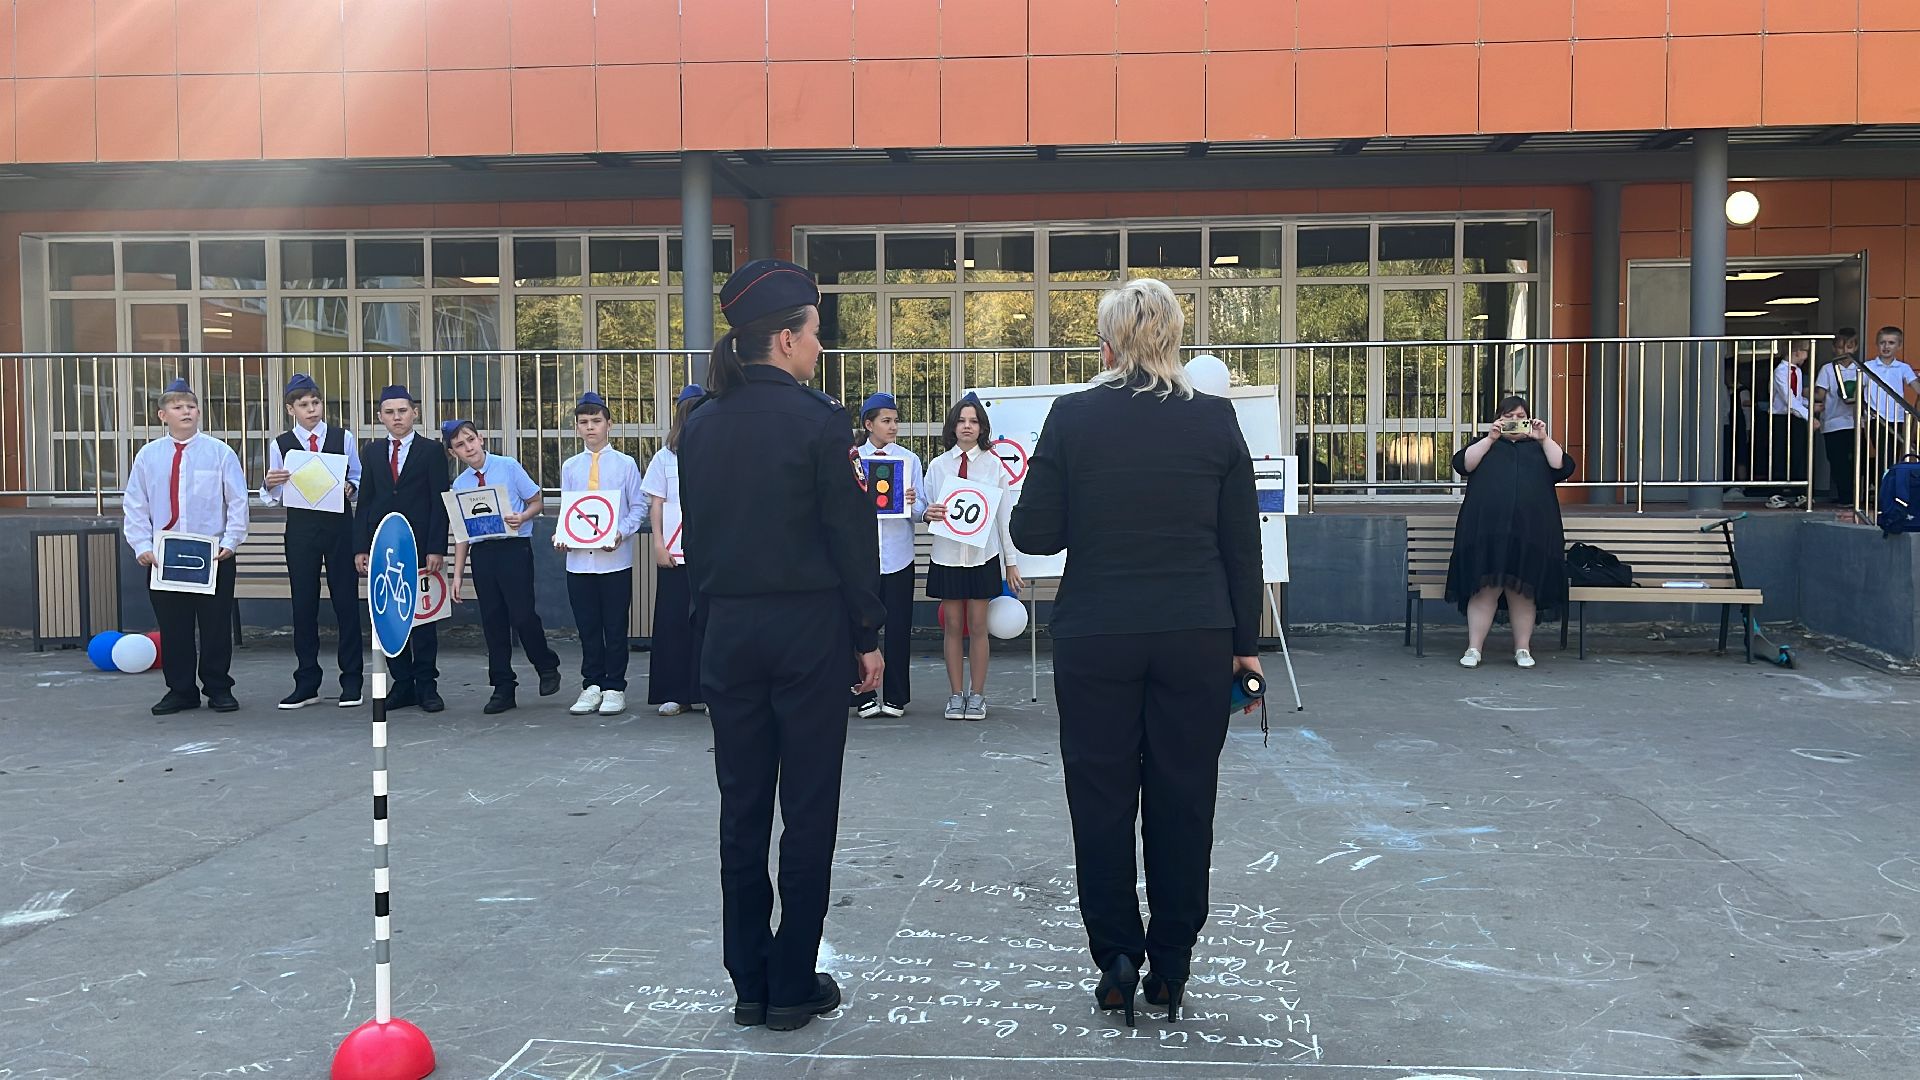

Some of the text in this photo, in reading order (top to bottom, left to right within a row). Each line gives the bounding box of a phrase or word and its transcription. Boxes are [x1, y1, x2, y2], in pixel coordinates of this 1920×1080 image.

[949, 498, 981, 524] 50
[1217, 920, 1296, 934] Это
[1265, 958, 1297, 976] И
[1278, 996, 1301, 1011] А
[866, 1006, 934, 1025] тут
[1258, 1013, 1311, 1034] На
[961, 1014, 1019, 1039] вы
[1052, 1023, 1324, 1061] Катайтесь
